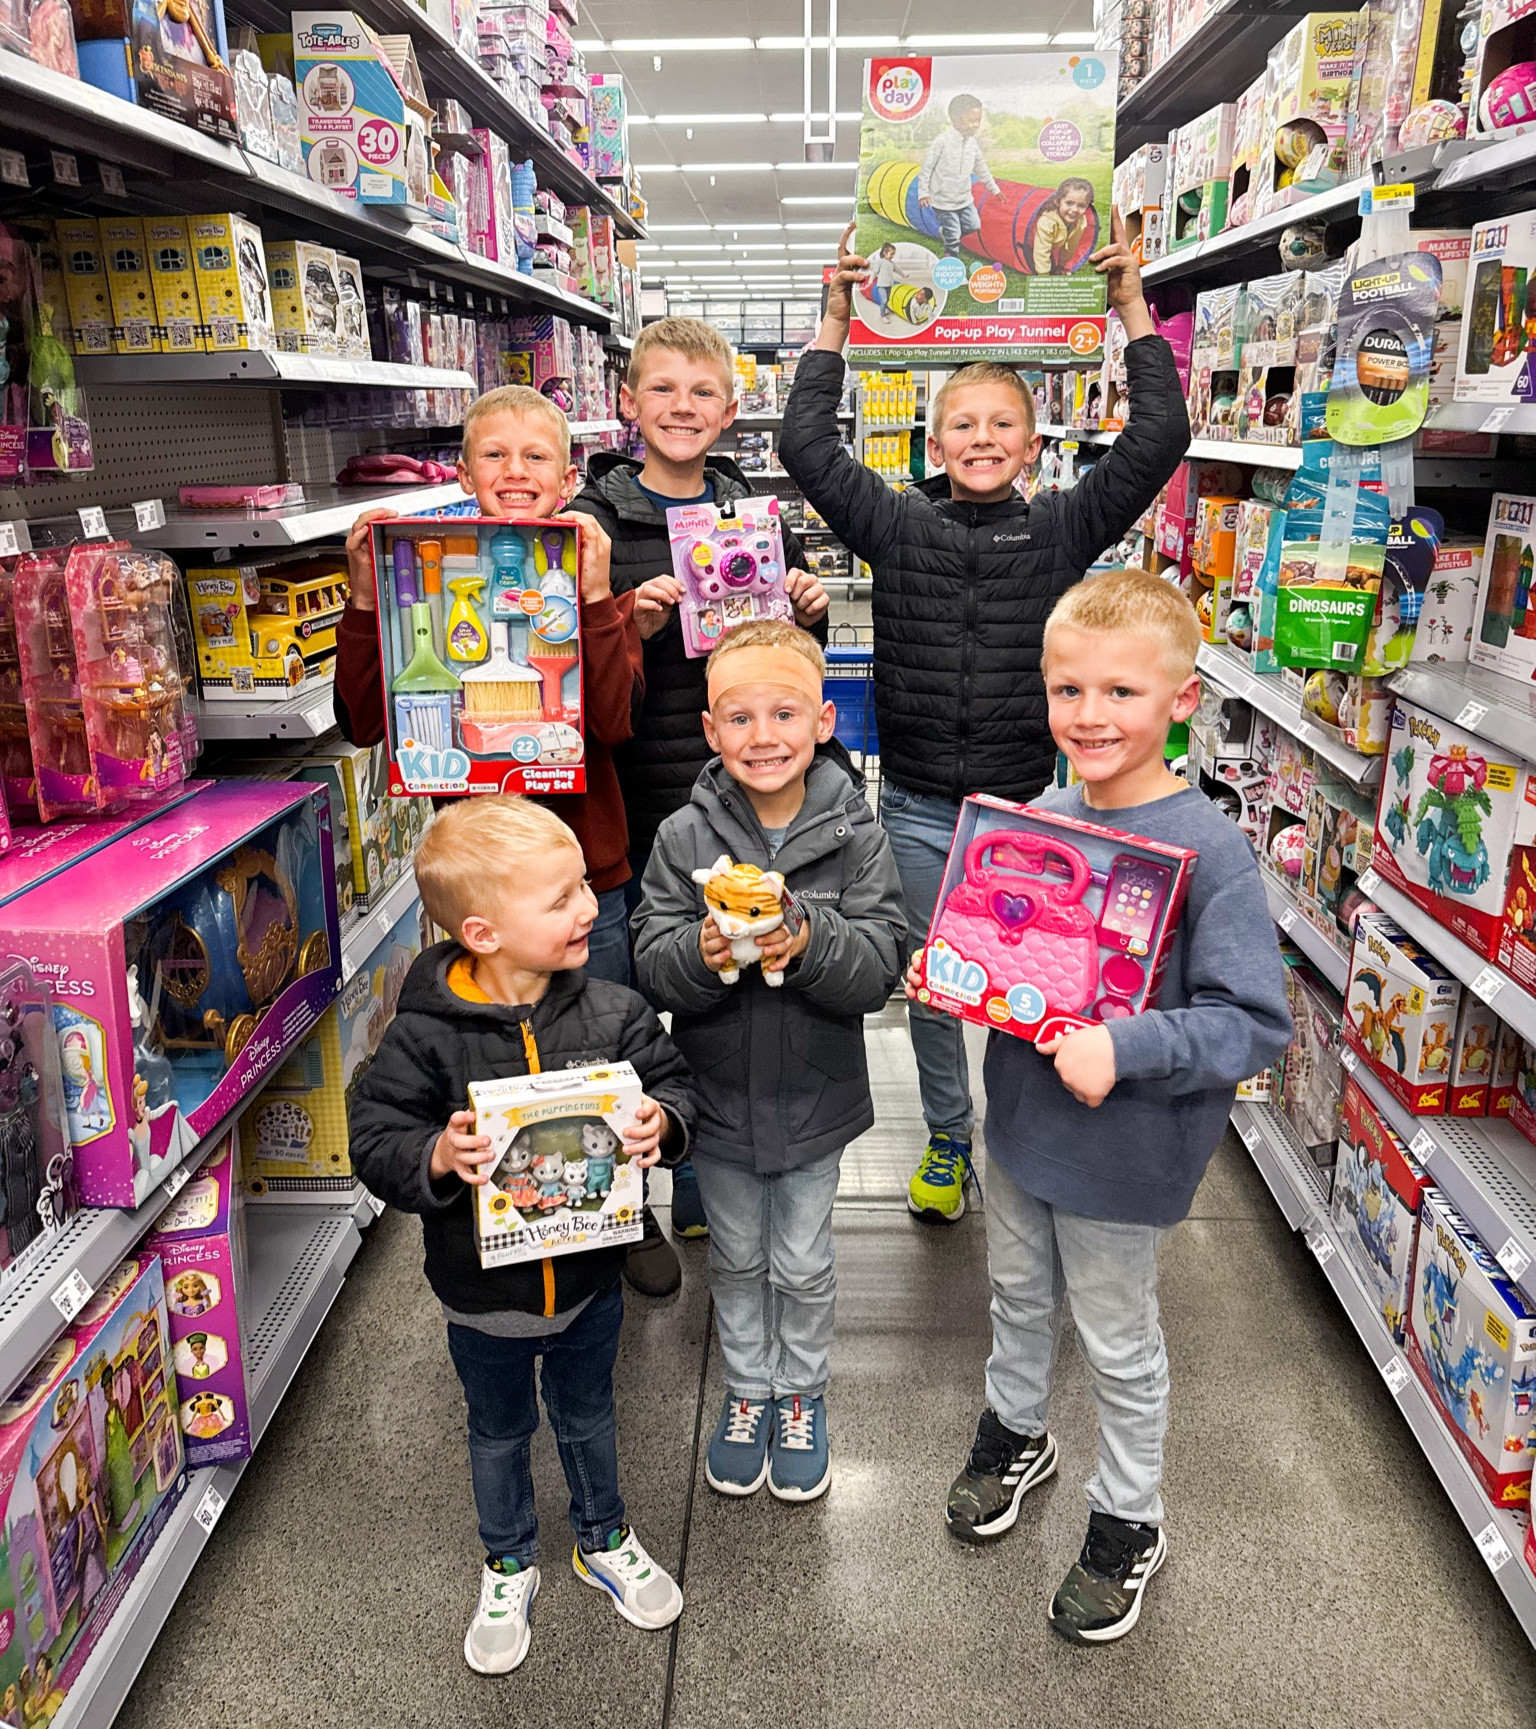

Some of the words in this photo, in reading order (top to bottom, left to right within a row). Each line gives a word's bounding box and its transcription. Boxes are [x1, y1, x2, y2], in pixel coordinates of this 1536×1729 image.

[298, 33, 360, 49] TOTE-ABLES
[1319, 23, 1358, 44] MINI
[1085, 63, 1092, 78] 1
[1322, 69, 1353, 77] BIRTHDA
[882, 75, 919, 93] play
[884, 90, 914, 106] day
[360, 126, 396, 154] 30
[1428, 240, 1459, 251] MAKE
[1439, 250, 1470, 260] LIFESTY
[1354, 274, 1398, 291] LIGHT-UP
[1352, 282, 1416, 301] FOOTBALL
[935, 326, 982, 341] Pop-up
[986, 325, 1016, 340] Play
[1019, 324, 1065, 338] Tunnel
[1074, 334, 1095, 349] 2+
[1364, 336, 1406, 351] DURA
[929, 348, 950, 356] Tunnel
[1517, 375, 1529, 389] 60
[1, 442, 24, 450] INCESS
[675, 518, 710, 530] MINNIE
[1000, 532, 1031, 542] Columbia
[1386, 536, 1416, 545] BALL
[1436, 554, 1450, 562] AKE
[195, 579, 219, 594] Honey
[219, 580, 234, 593] Bee
[1289, 599, 1366, 617] DINOSAURS
[517, 741, 534, 750] 22
[400, 751, 468, 781] KID
[522, 768, 576, 780] Cleaning
[408, 782, 465, 790] Connection
[525, 780, 551, 792] Play
[553, 779, 573, 789] Set
[1125, 872, 1155, 890] 12:45
[801, 890, 840, 900] Columbia
[7, 953, 69, 980] Disney
[930, 950, 985, 993] KID
[929, 980, 978, 1003] Connection
[1021, 992, 1032, 1009] 5
[245, 1036, 270, 1062] Disney
[240, 1039, 281, 1089] PRINCESS
[525, 1219, 570, 1242] Honey
[572, 1215, 598, 1232] Bee
[169, 1243, 206, 1256] Disney
